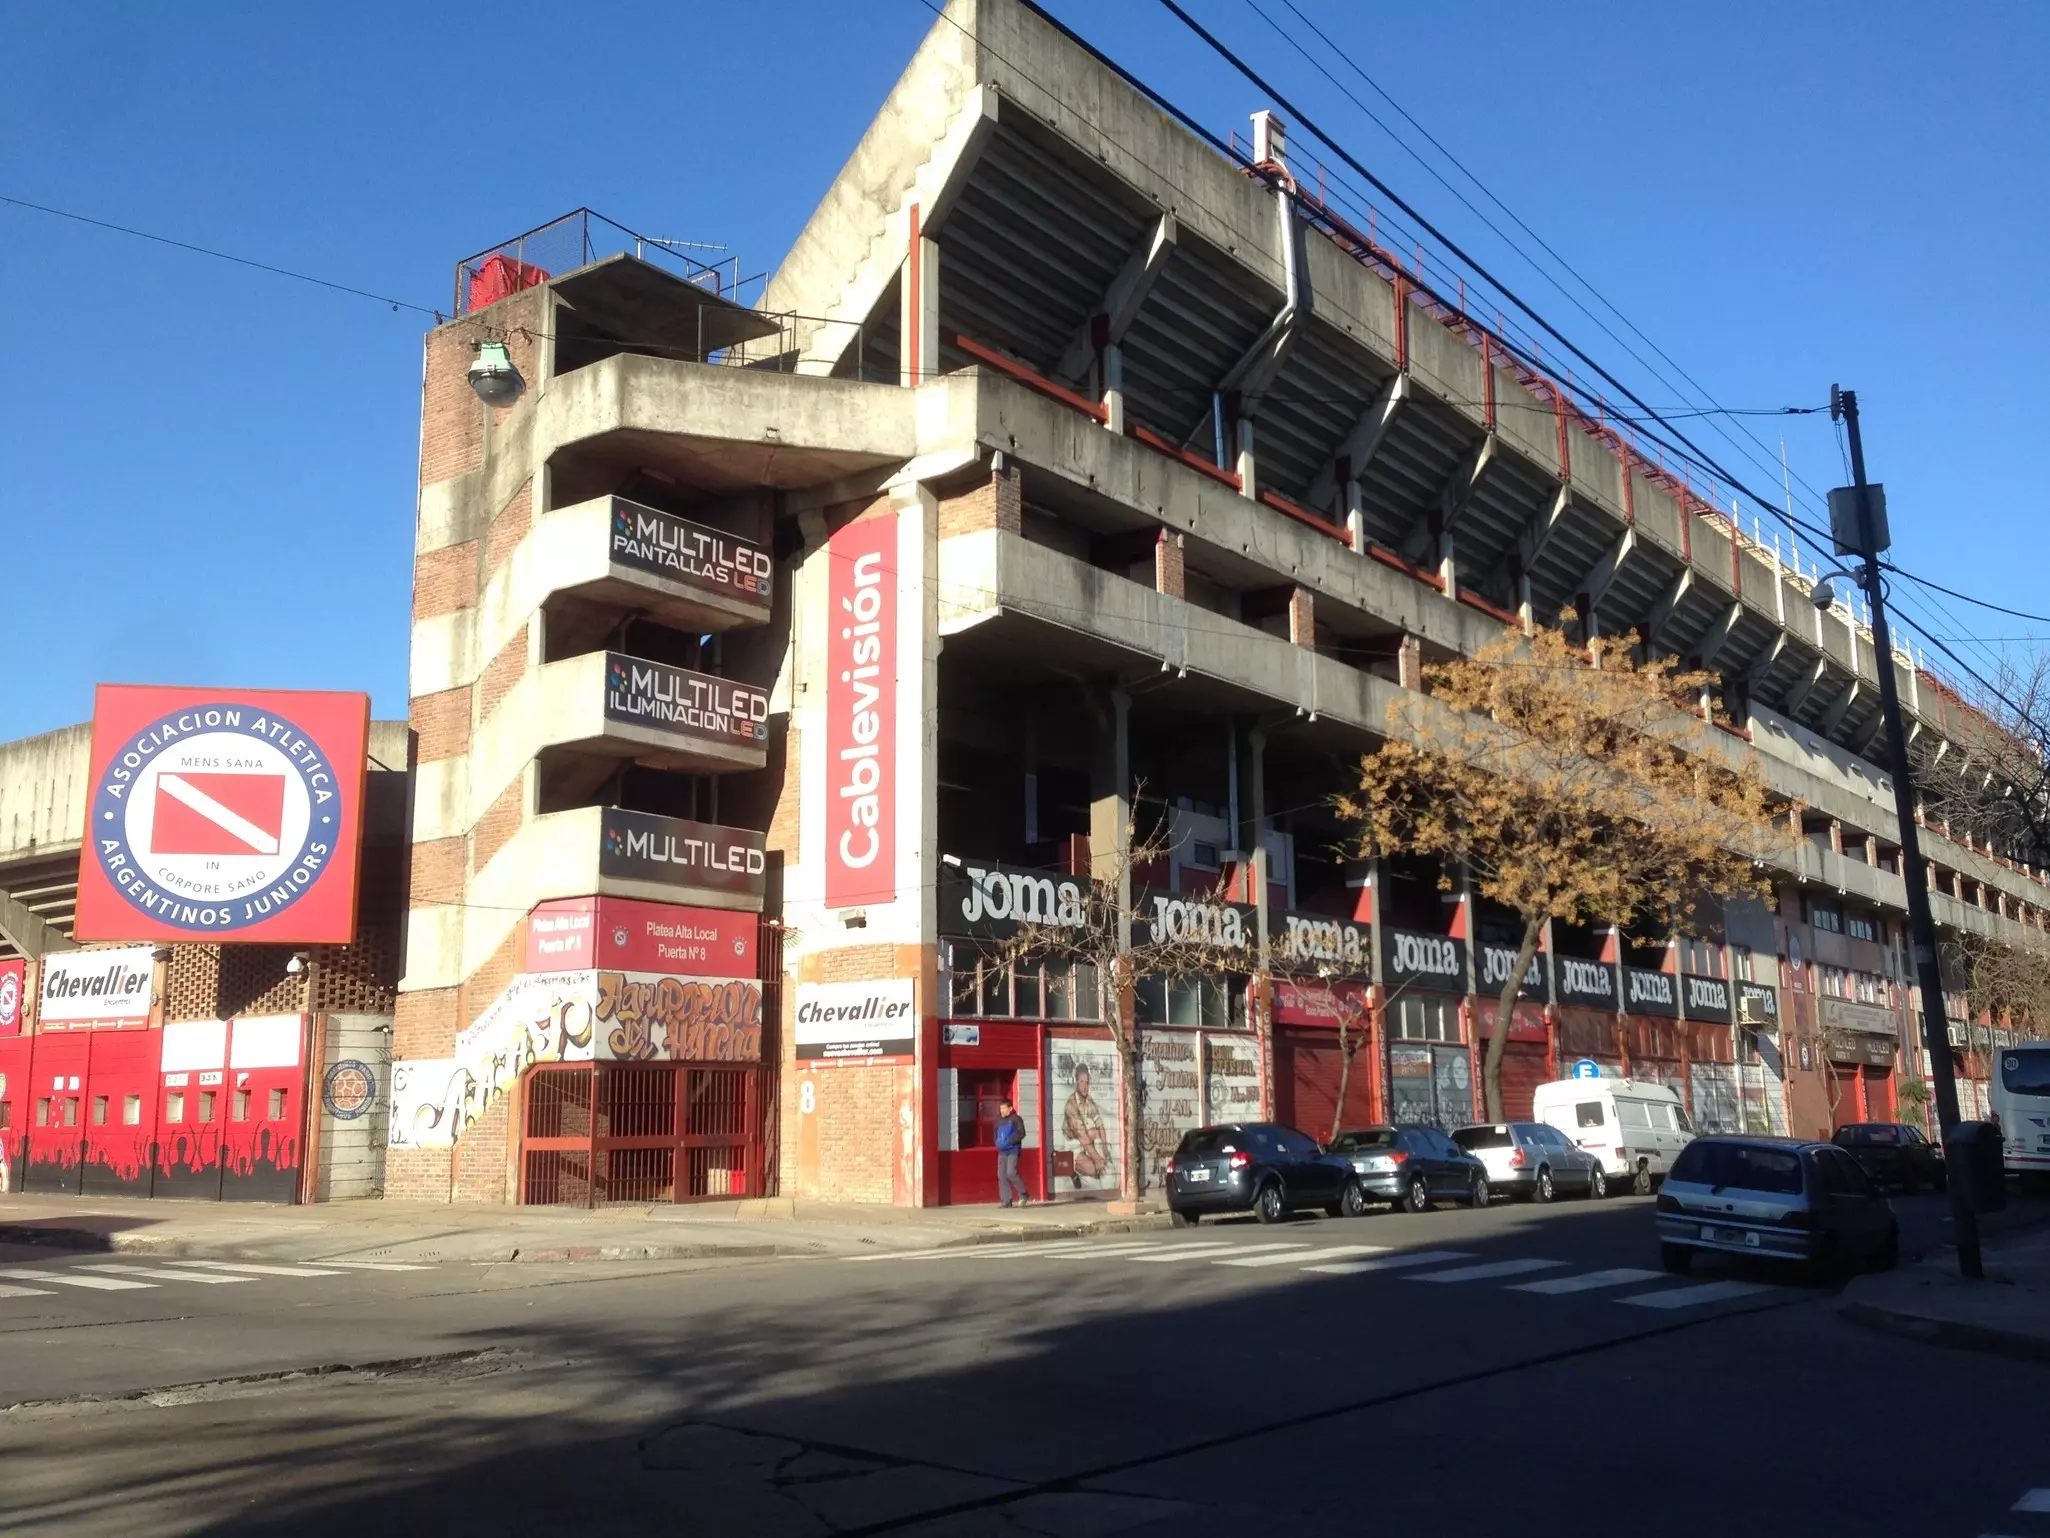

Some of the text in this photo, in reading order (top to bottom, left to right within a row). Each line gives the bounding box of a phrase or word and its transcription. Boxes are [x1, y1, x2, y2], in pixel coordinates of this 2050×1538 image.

[614, 534, 771, 596] PANTALLAS LED
[637, 513, 771, 578] MULTILED
[631, 665, 768, 723] MULTILED
[840, 551, 881, 869] Cablevisión
[610, 690, 768, 741] ILUMINACION LED
[106, 709, 333, 805] ASOCIACION ATLETICA
[181, 756, 264, 769] MENS SANA
[205, 860, 220, 870] IN
[626, 828, 765, 875] MULTILED
[100, 837, 328, 926] ARGENTINOS JUNIORS
[158, 866, 267, 894] CORPORE SANO
[646, 921, 717, 942] Platea Alta Local
[658, 945, 687, 960] Puerta
[700, 947, 706, 961] 8
[46, 965, 149, 999] Chevallier
[797, 996, 910, 1024] Chevallier
[608, 1014, 659, 1060] del
[1579, 1065, 1592, 1078] E
[800, 1080, 816, 1113] 8
